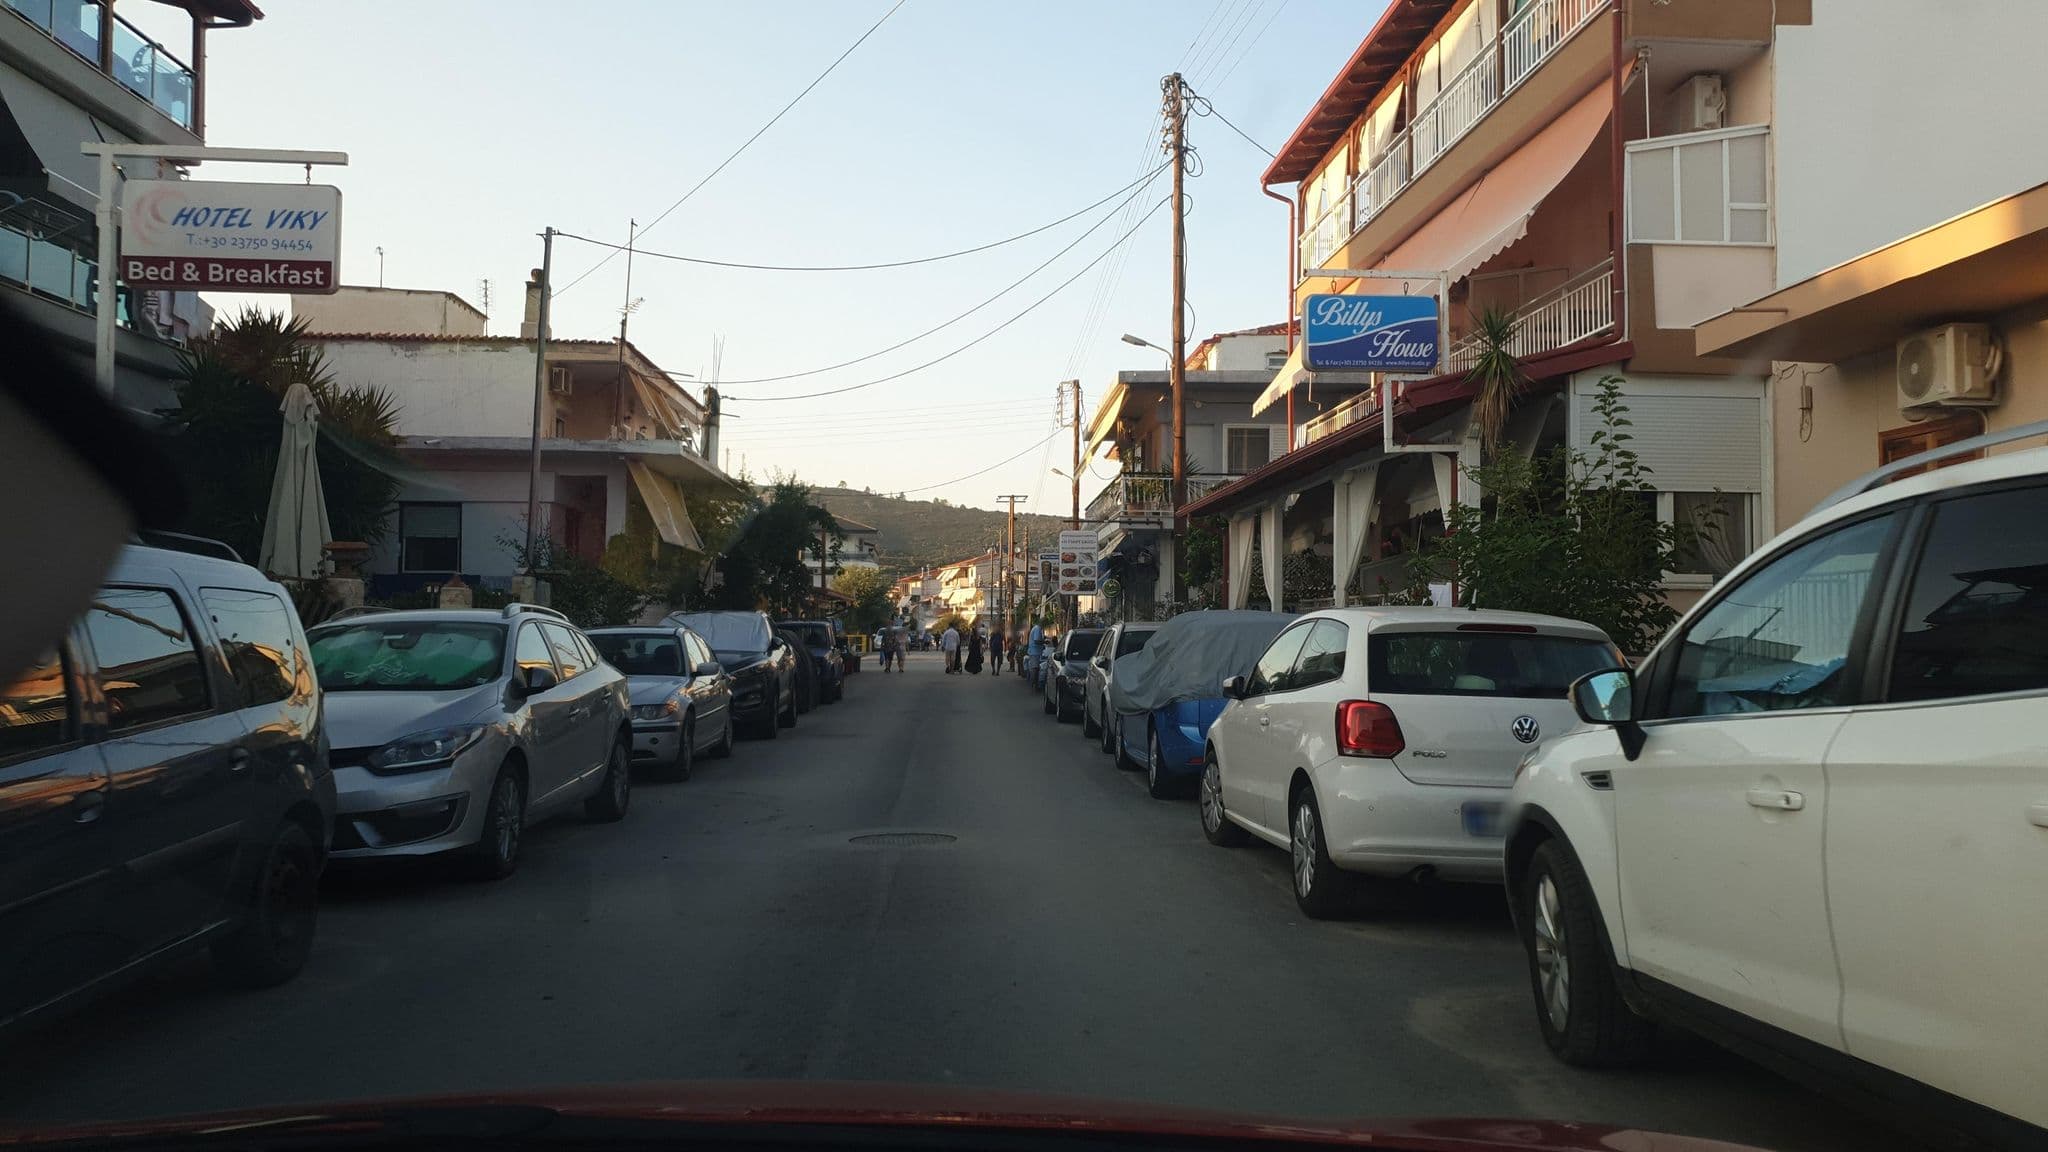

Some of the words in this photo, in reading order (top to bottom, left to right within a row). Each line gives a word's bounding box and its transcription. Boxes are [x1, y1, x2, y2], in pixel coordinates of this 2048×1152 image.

[172, 206, 252, 228] HOTEL
[266, 208, 329, 231] VIKY
[231, 237, 269, 250] 23750
[272, 238, 313, 251] 94454
[128, 260, 175, 281] Bed
[182, 263, 201, 282] &
[208, 263, 325, 285] Breakfast
[1312, 297, 1383, 335] Billys
[1368, 329, 1434, 358] House
[1412, 750, 1448, 759] POLO
